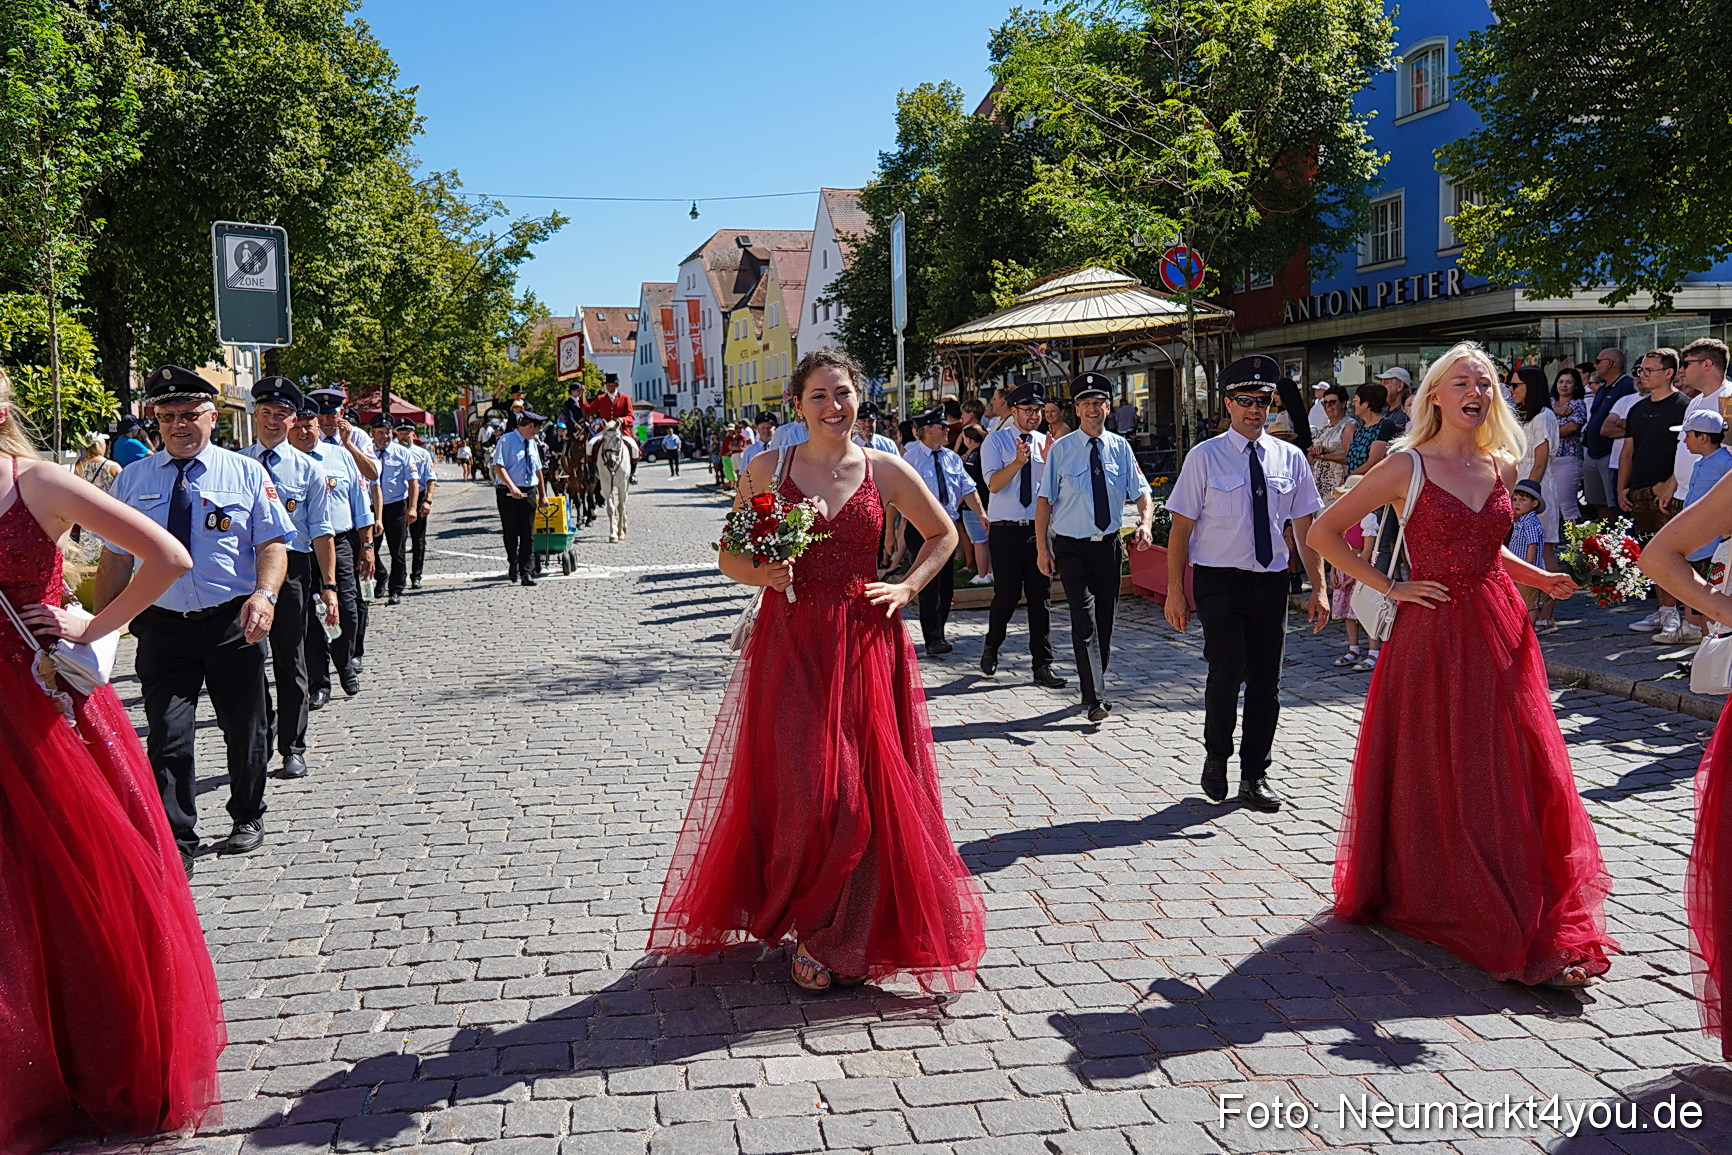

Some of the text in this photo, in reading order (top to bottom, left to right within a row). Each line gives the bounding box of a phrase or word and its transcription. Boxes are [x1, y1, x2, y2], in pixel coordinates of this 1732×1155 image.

[239, 277, 265, 287] ZONE
[1283, 268, 1461, 324] ANTON PETER
[690, 321, 703, 355] SALE
